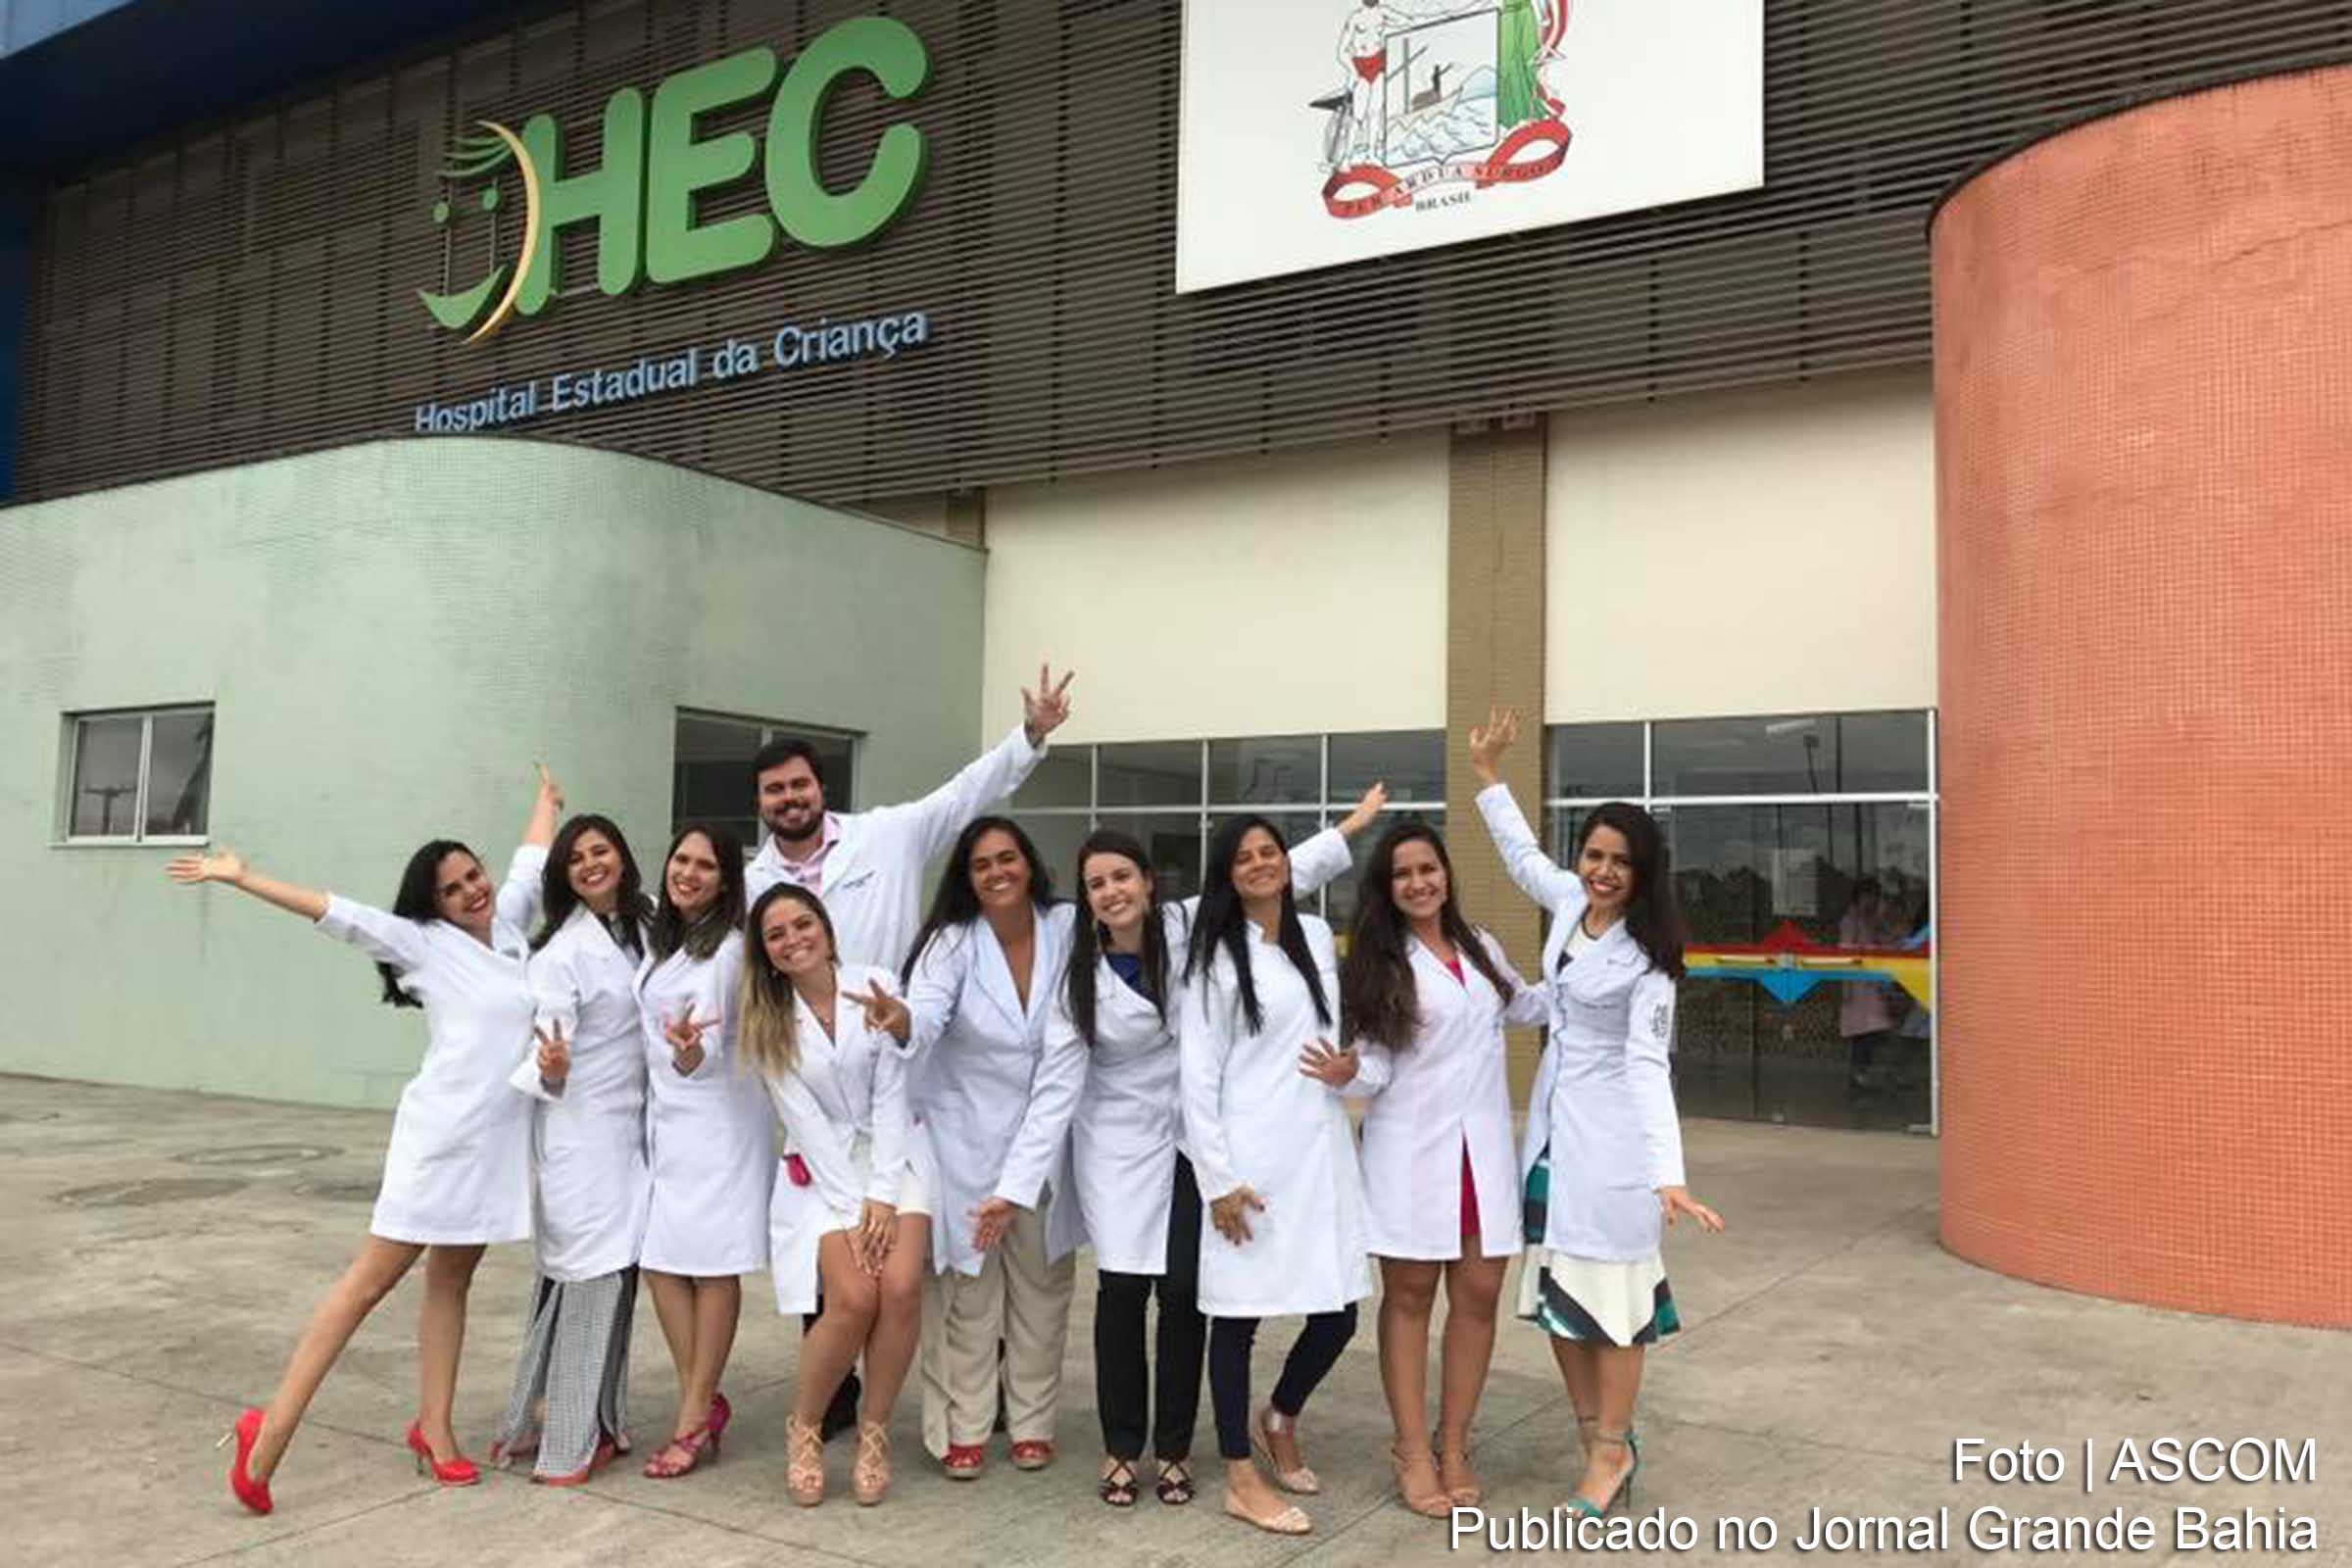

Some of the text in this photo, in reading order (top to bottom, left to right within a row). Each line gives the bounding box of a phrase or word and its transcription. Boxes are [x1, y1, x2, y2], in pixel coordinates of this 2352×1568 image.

[514, 16, 929, 316] HEC
[1415, 190, 1471, 212] BRASIL
[415, 312, 927, 432] Hospital Estadual da Criança
